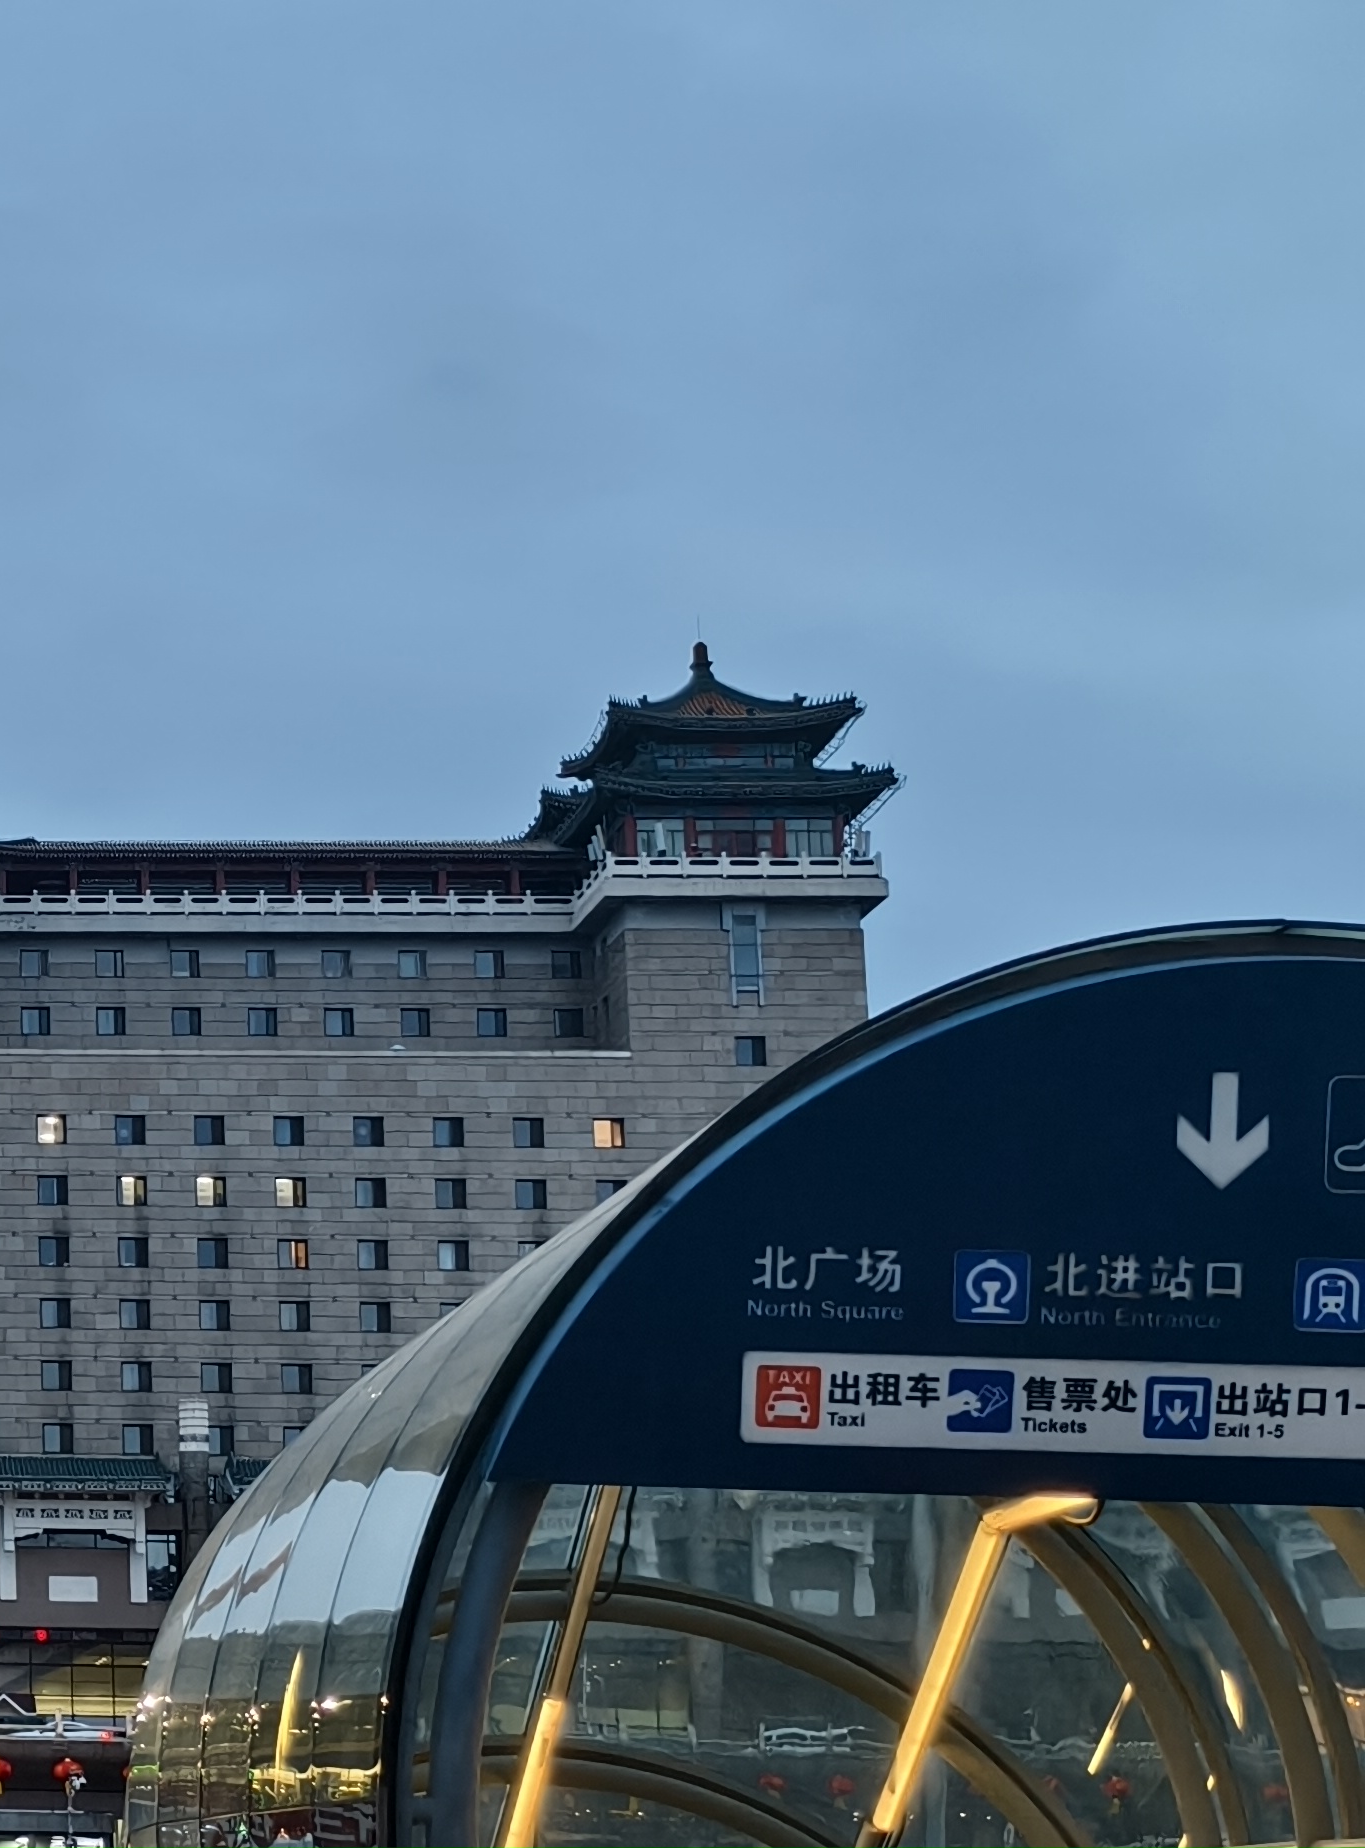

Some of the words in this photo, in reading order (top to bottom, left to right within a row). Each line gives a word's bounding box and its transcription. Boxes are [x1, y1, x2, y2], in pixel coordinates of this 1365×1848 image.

[752, 1246, 902, 1292] 北广场
[1044, 1252, 1244, 1300] 北进站口
[748, 1299, 811, 1318] North
[821, 1301, 904, 1323] Square
[1041, 1306, 1105, 1326] North
[1116, 1308, 1221, 1329] Entrance
[768, 1370, 810, 1384] TAXI
[828, 1371, 941, 1408] 出租车
[1022, 1376, 1137, 1413] 售票处
[827, 1412, 865, 1427] Taxi
[1021, 1418, 1087, 1434] Tickets
[1214, 1423, 1249, 1438] Exit
[1256, 1423, 1284, 1439] 1-5
